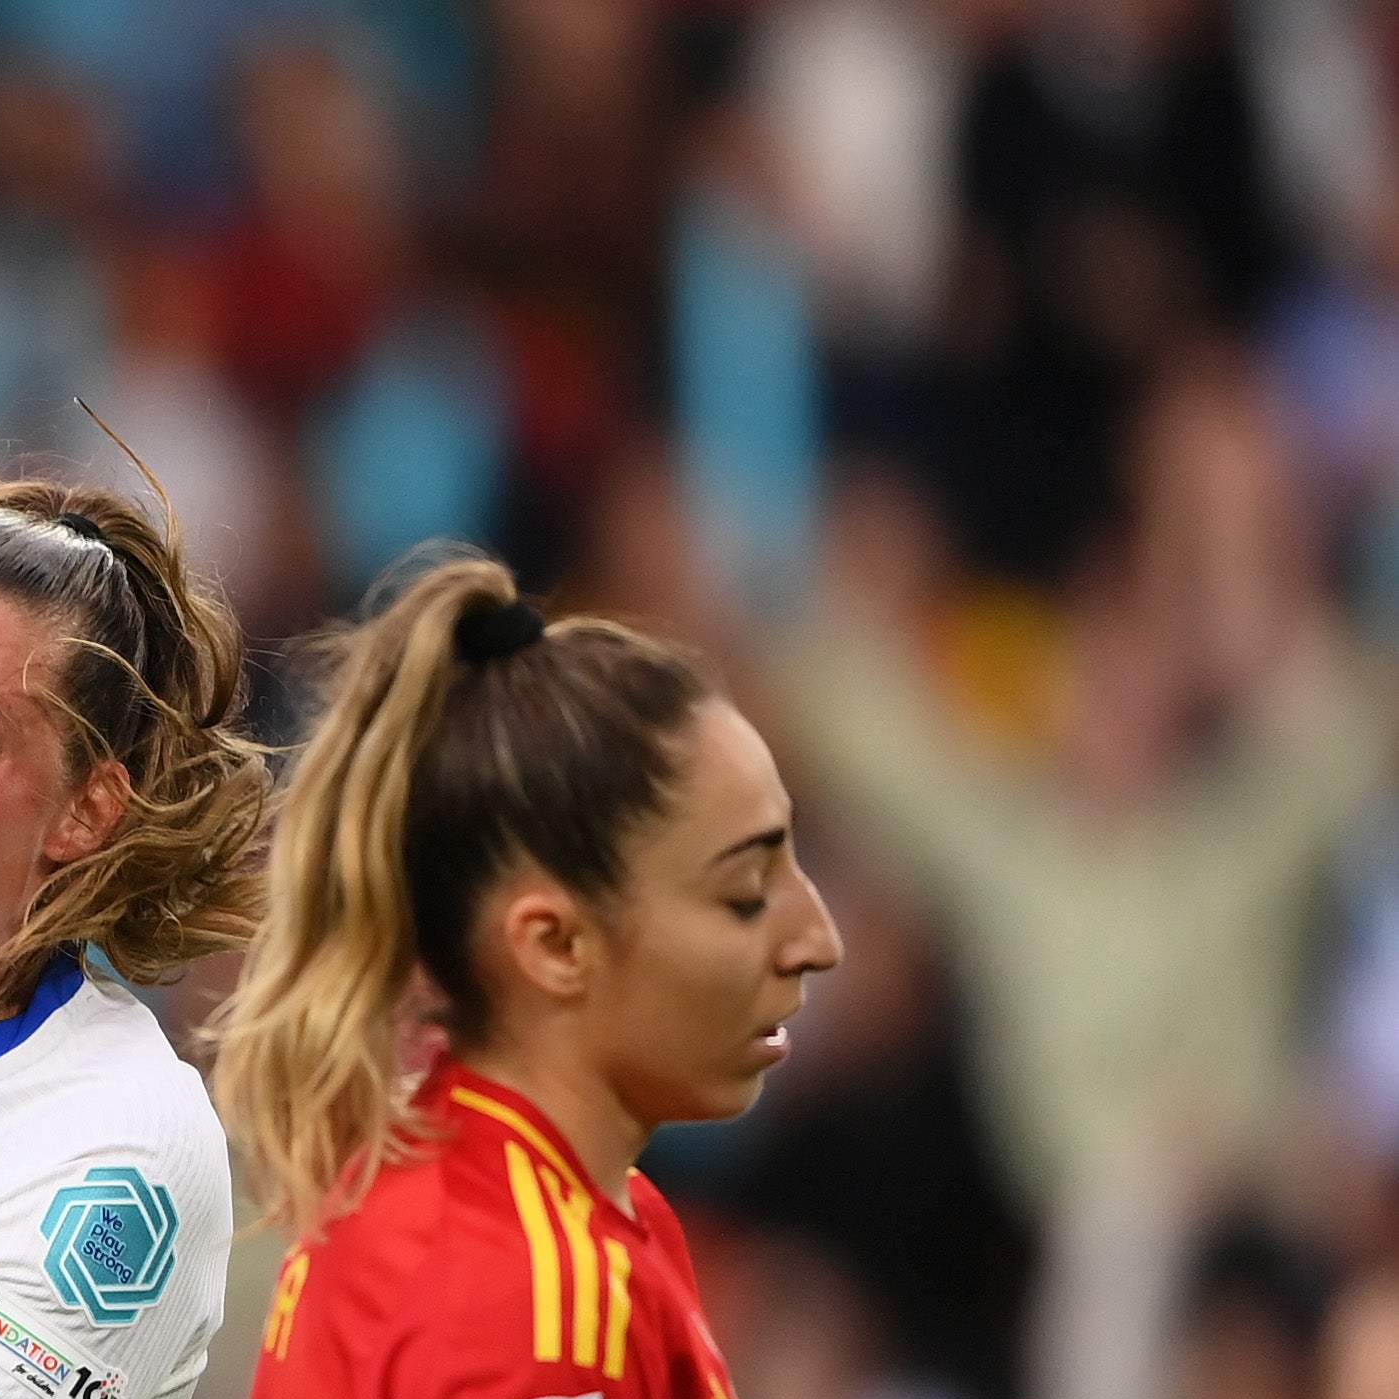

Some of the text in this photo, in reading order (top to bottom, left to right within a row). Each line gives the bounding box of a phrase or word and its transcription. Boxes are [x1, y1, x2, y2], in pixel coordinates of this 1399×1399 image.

[102, 1207, 123, 1231] We
[91, 1224, 125, 1257] Play
[83, 1240, 133, 1284] Strong
